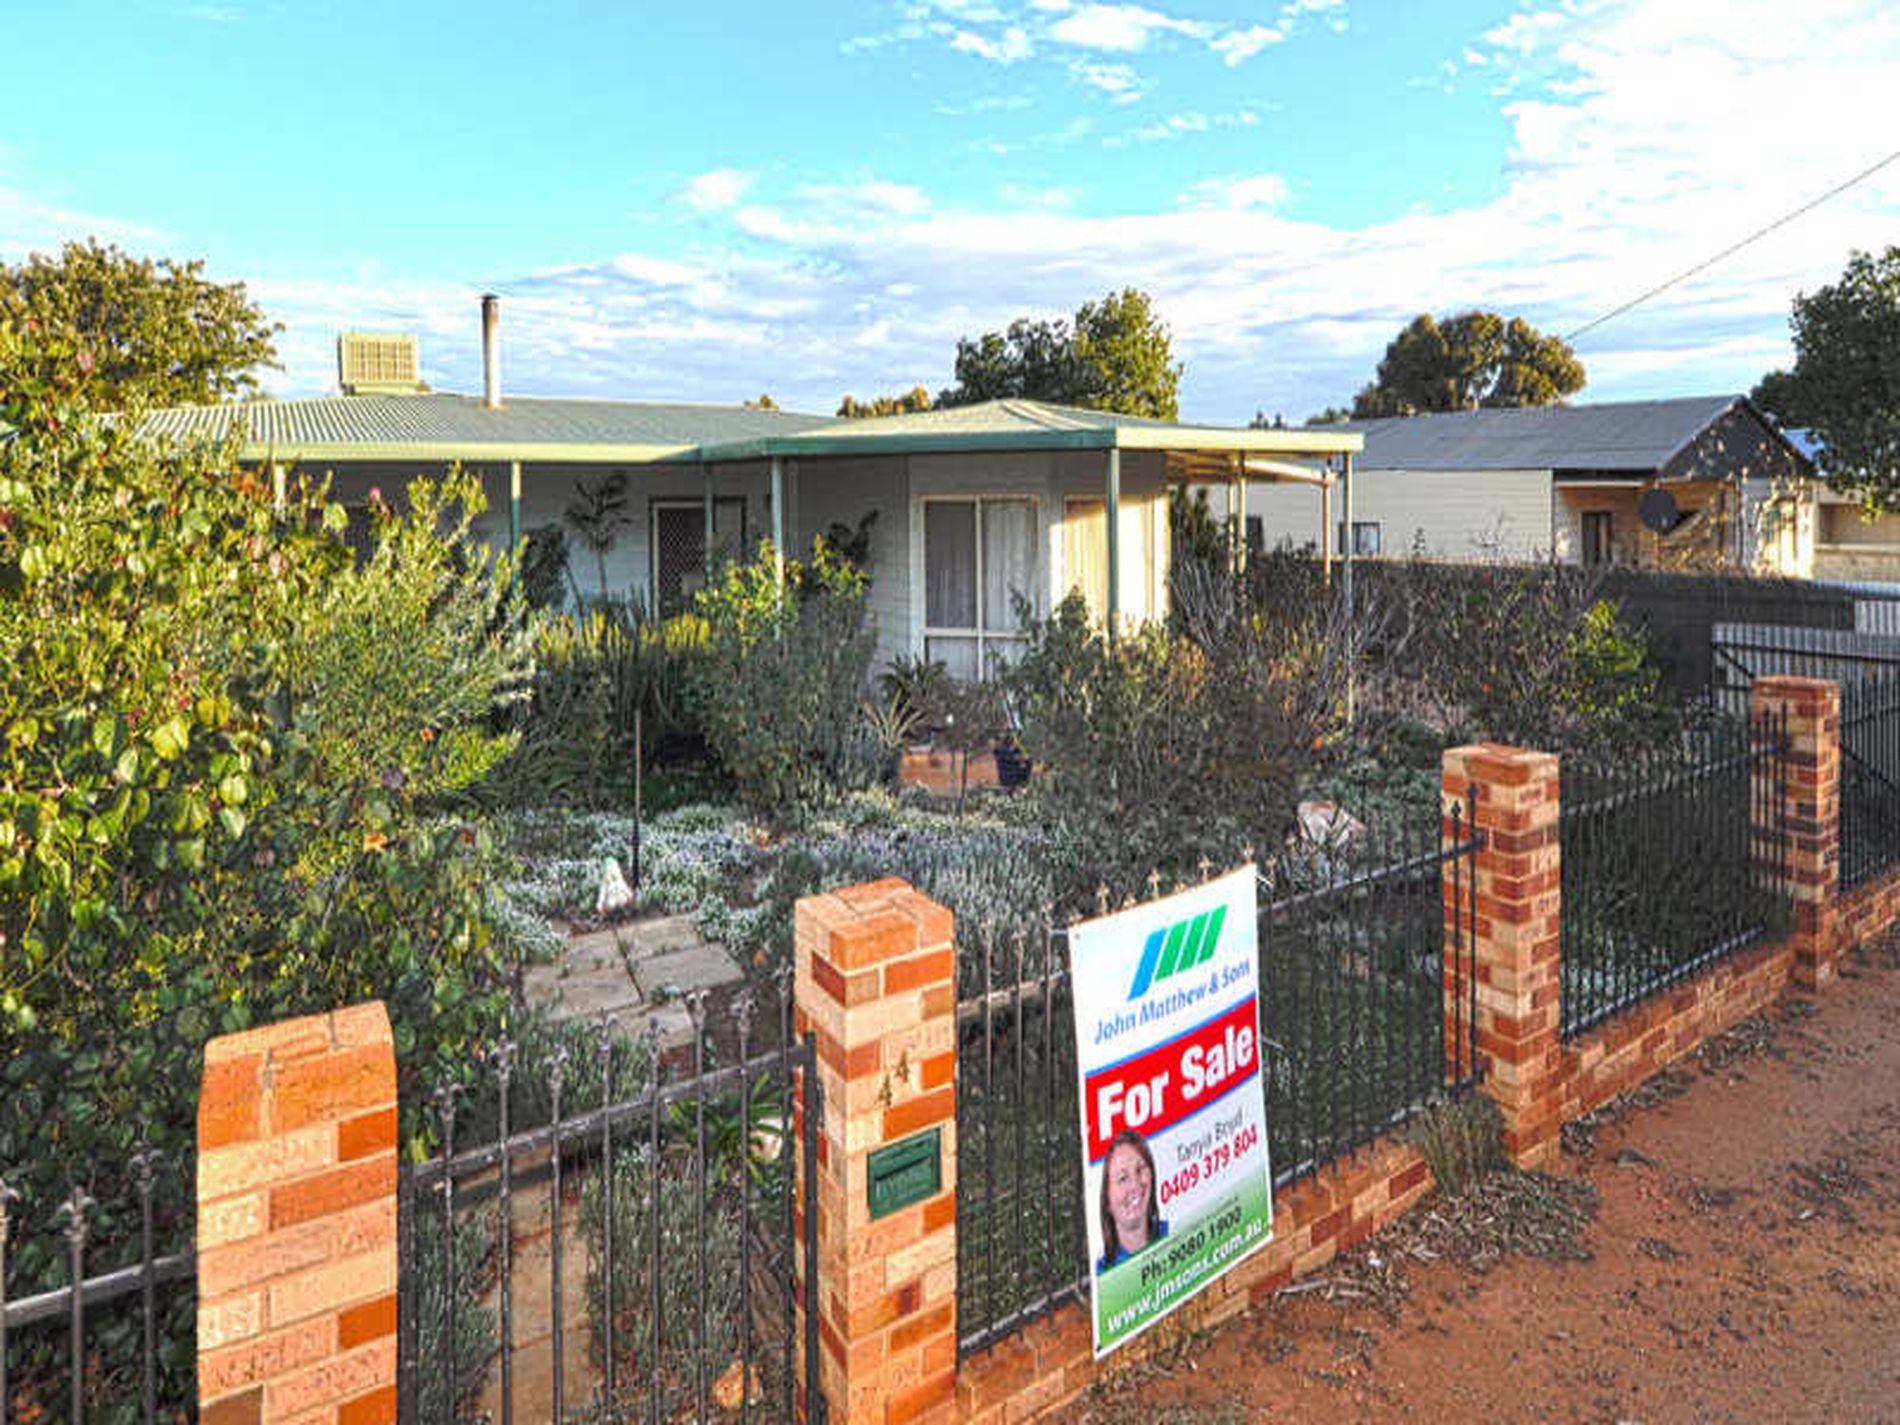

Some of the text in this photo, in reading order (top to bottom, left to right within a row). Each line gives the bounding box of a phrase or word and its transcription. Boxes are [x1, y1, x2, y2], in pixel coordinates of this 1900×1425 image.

[1094, 960, 1250, 1045] John Matthew & Sons
[1097, 1025, 1254, 1141] For Sale
[1160, 1123, 1257, 1205] 0409 379 804
